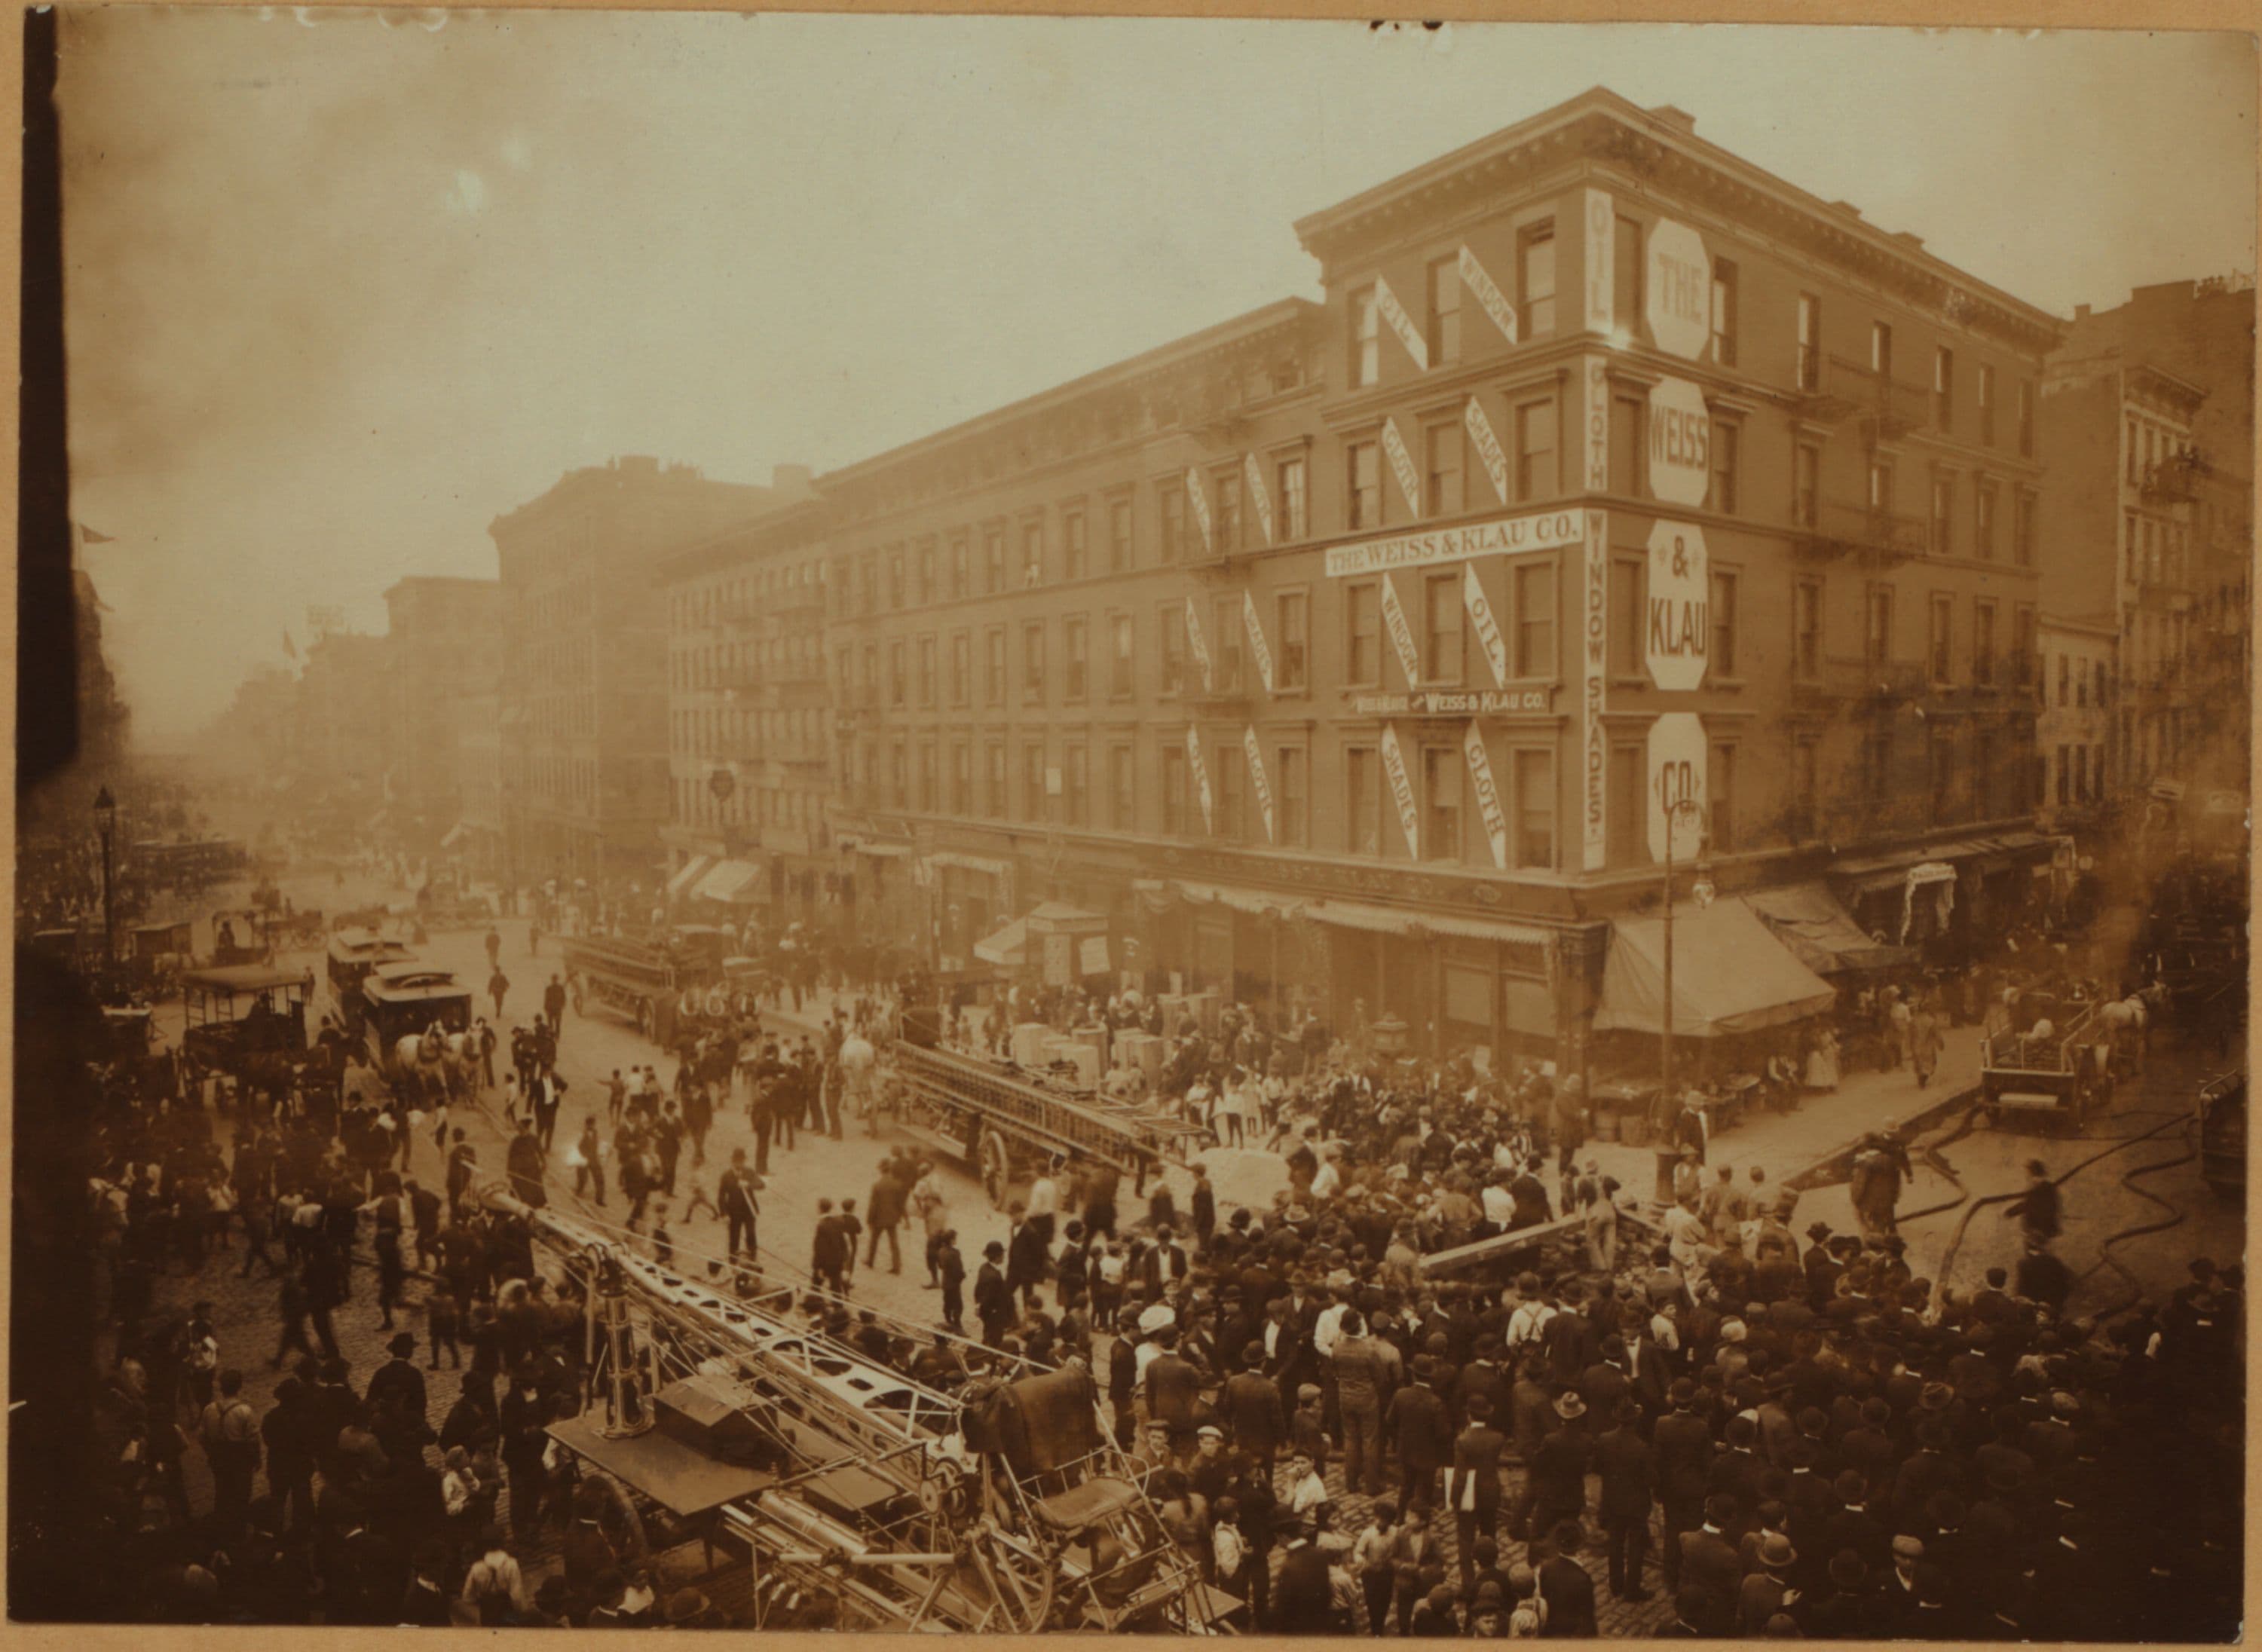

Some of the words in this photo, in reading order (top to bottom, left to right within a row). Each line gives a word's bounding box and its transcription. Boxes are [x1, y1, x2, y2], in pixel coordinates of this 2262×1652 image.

[1590, 199, 1608, 320] OIL
[1660, 252, 1701, 324] THE
[1590, 363, 1605, 490] CLOTH
[1650, 405, 1706, 472] WEISS
[1330, 552, 1366, 573] THE
[1366, 534, 1435, 567] WEISS
[1441, 534, 1458, 555] &
[1459, 522, 1526, 552] KLAU
[1536, 514, 1578, 541] CO.
[1672, 535, 1690, 579] &
[1588, 512, 1603, 662] WINDOW
[1651, 597, 1706, 657] KLAU
[1426, 691, 1465, 714] WEISS
[1481, 690, 1520, 711] KLAU
[1385, 742, 1417, 829] SHADES
[1470, 744, 1507, 838] CLOTH
